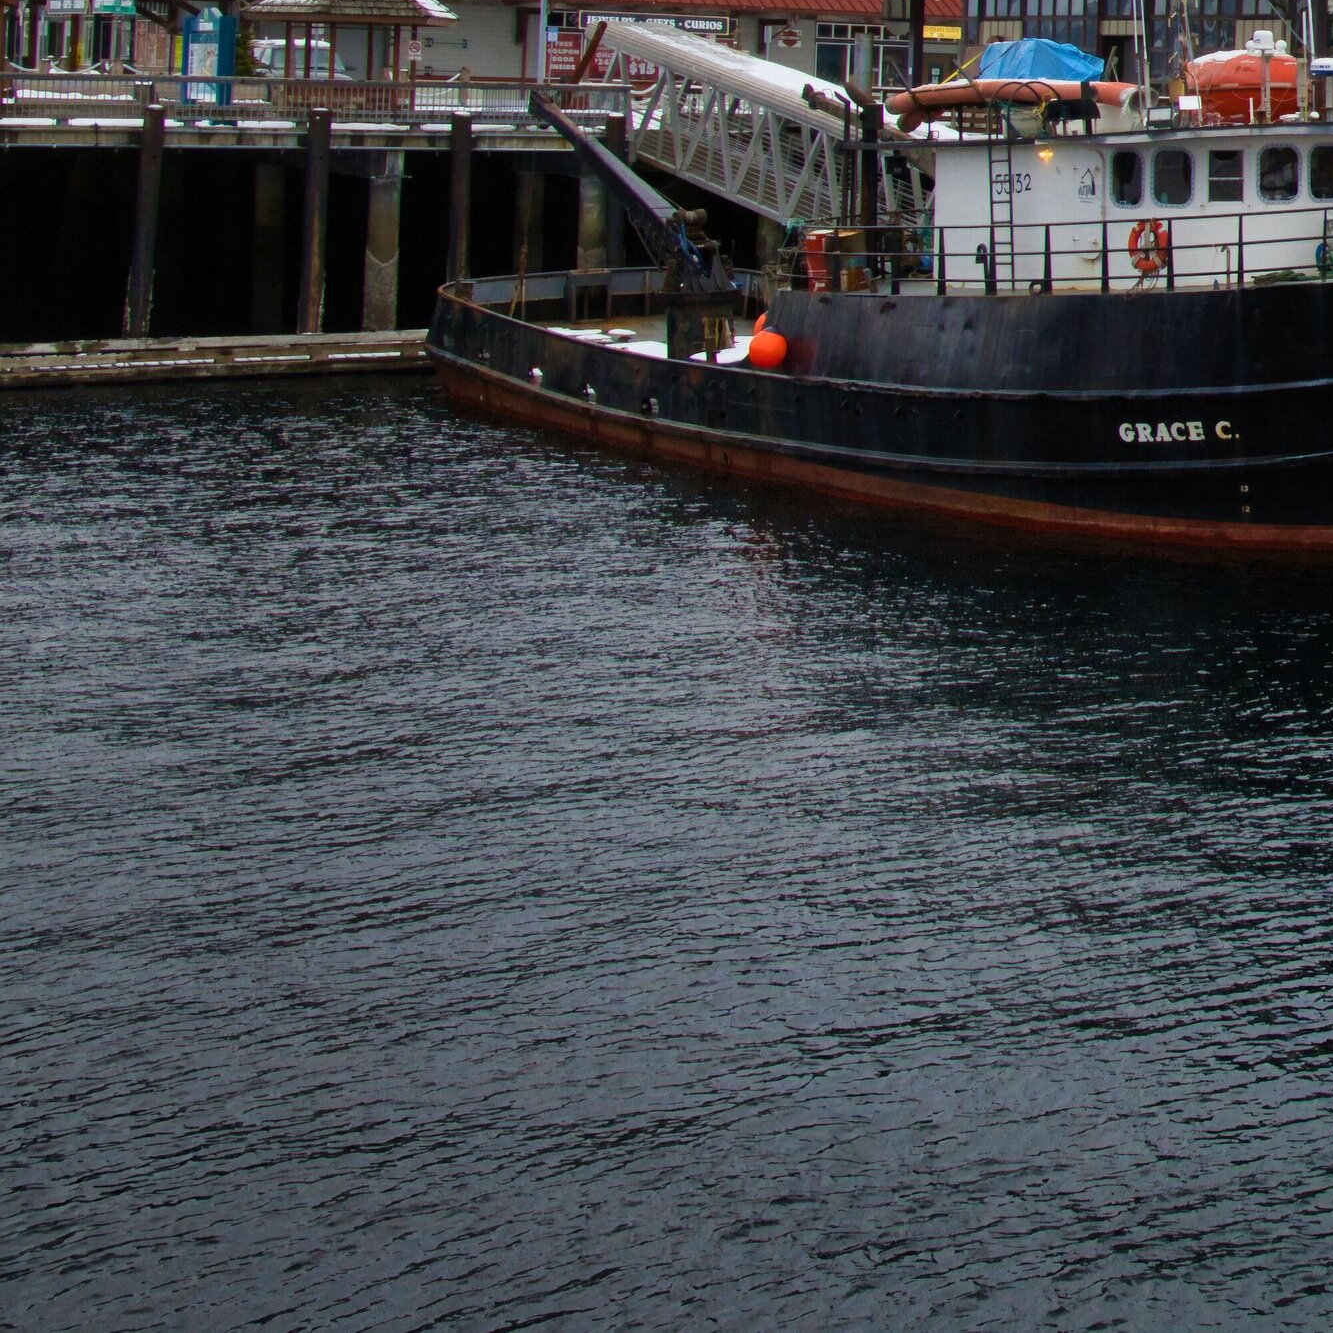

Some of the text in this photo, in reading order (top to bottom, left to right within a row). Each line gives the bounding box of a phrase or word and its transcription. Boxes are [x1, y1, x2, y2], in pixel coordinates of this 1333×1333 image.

[684, 19, 722, 30] CURIOS
[995, 173, 1032, 195] 55132
[1119, 420, 1240, 443] GRACE C.
